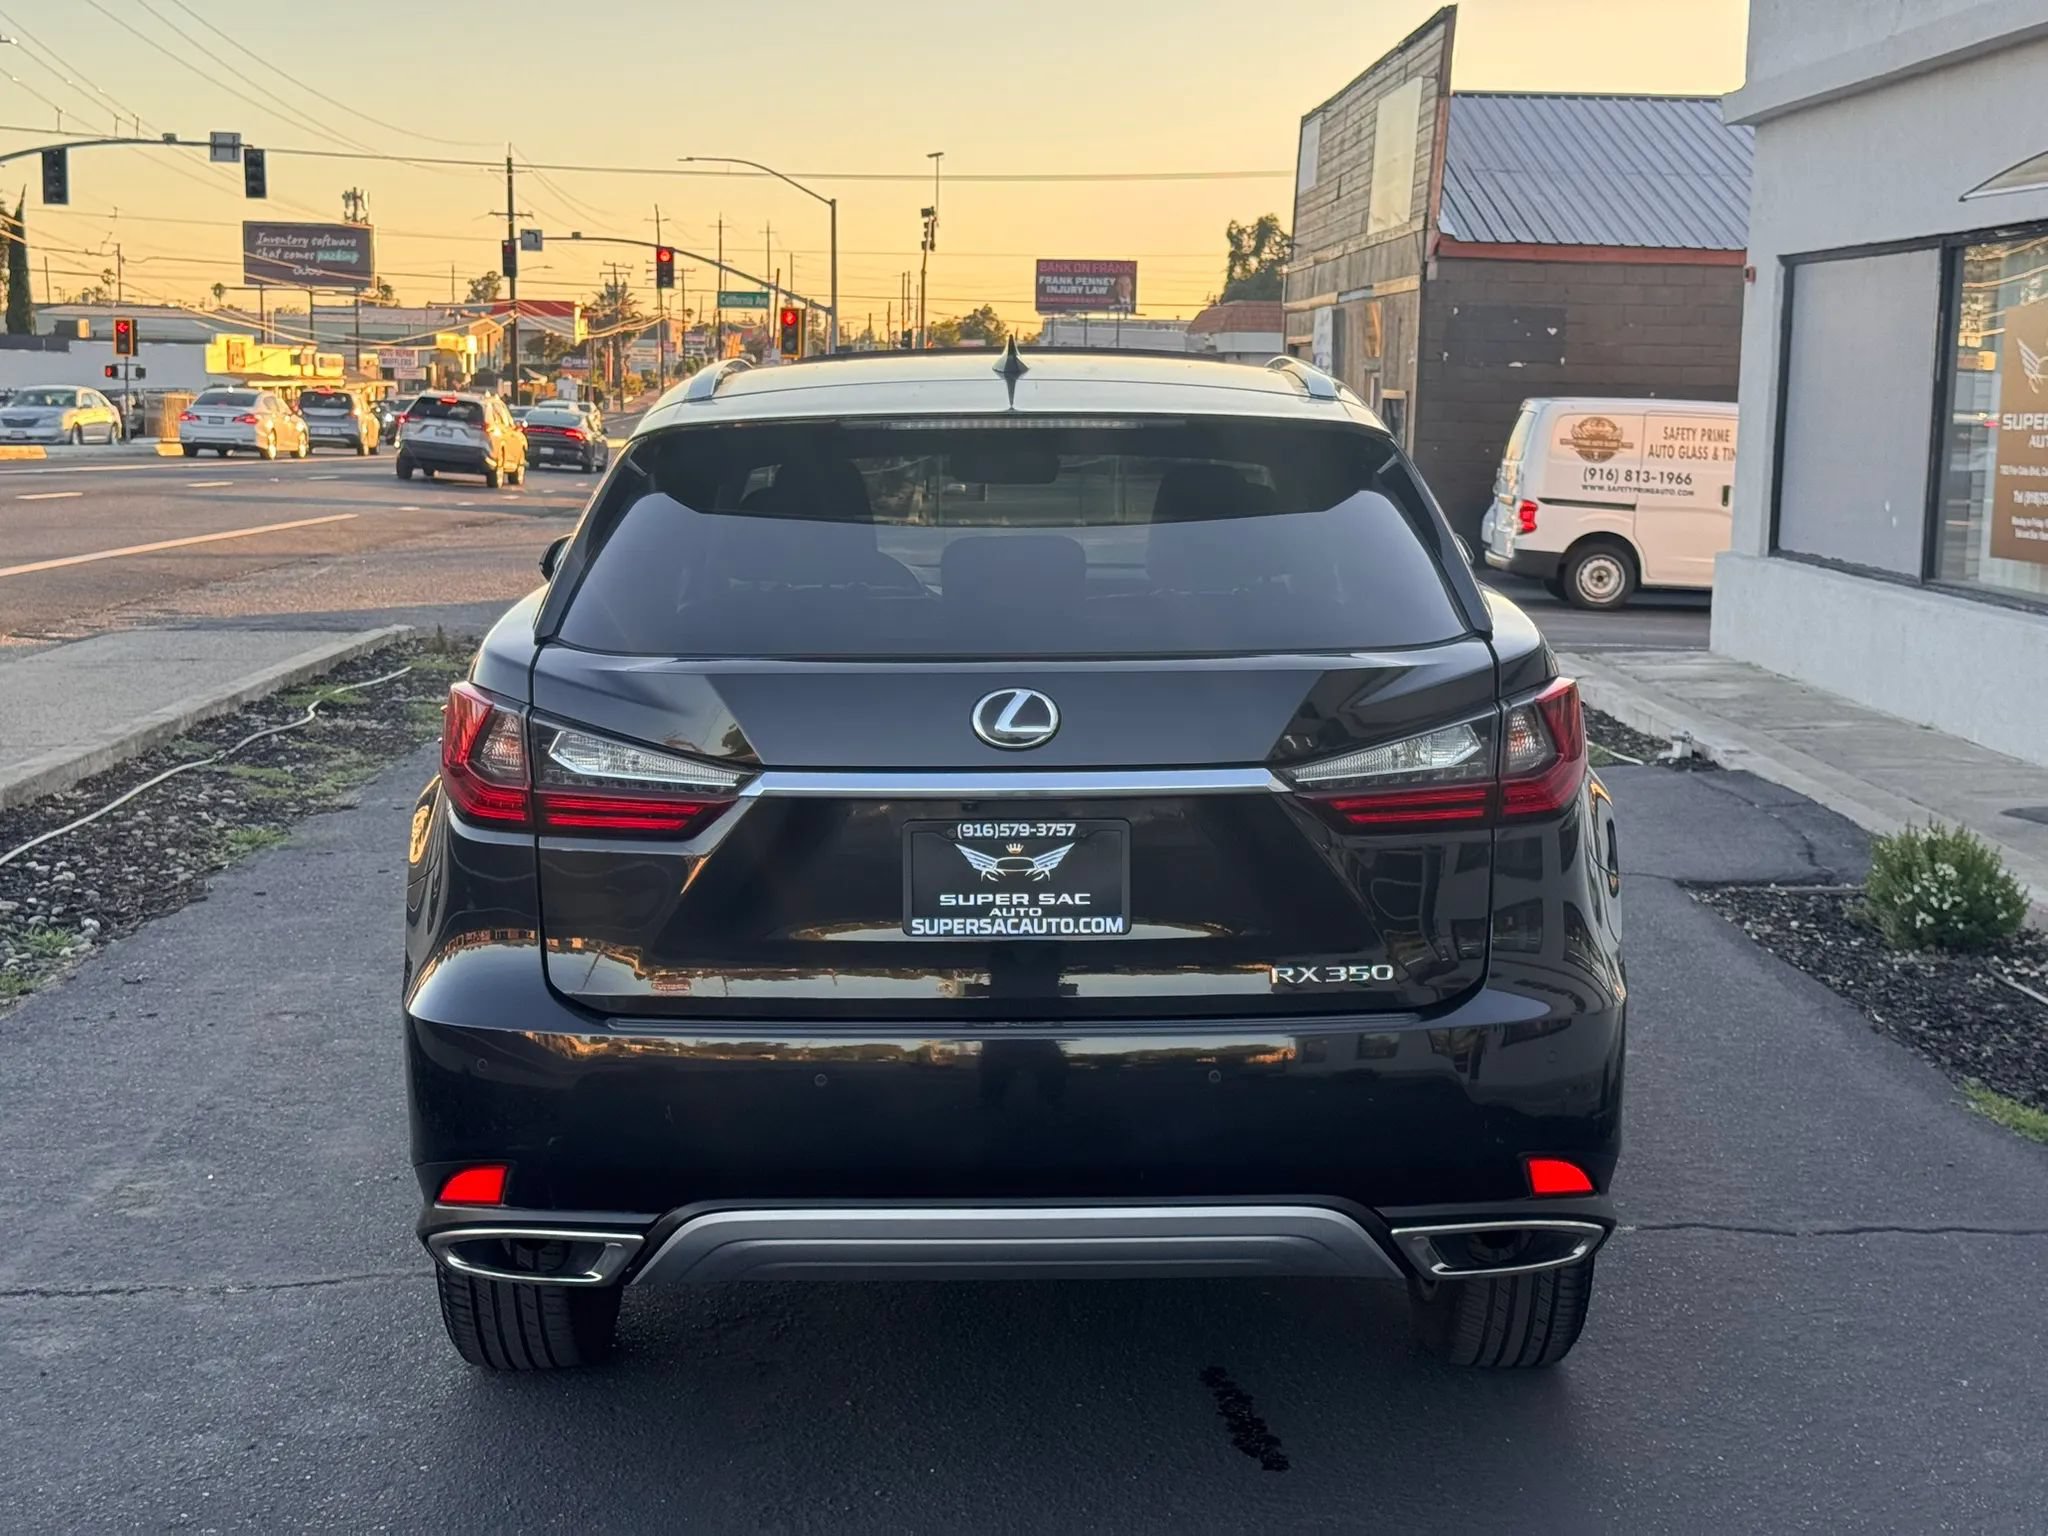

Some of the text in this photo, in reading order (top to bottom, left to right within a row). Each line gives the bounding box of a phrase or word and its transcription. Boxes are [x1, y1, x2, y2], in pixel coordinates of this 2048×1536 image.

[255, 231, 357, 248] Inventory software
[1040, 262, 1071, 273] BANK
[1073, 263, 1090, 273] ON
[1039, 275, 1116, 286] FRANK PENNEY
[1046, 284, 1109, 295] INJURY LAW
[1662, 425, 1731, 443] SAFETY PRIME
[1648, 443, 1675, 459] AUTO
[1678, 445, 1708, 461] GLASS
[1711, 446, 1719, 461] &
[1583, 466, 1693, 486] (916) 813-1966
[957, 823, 1077, 840] (916)579-3757
[939, 893, 1091, 906] SUPER SAC
[988, 907, 1042, 917] AUTO
[911, 916, 1124, 935] SUPERSACAUTO.COM
